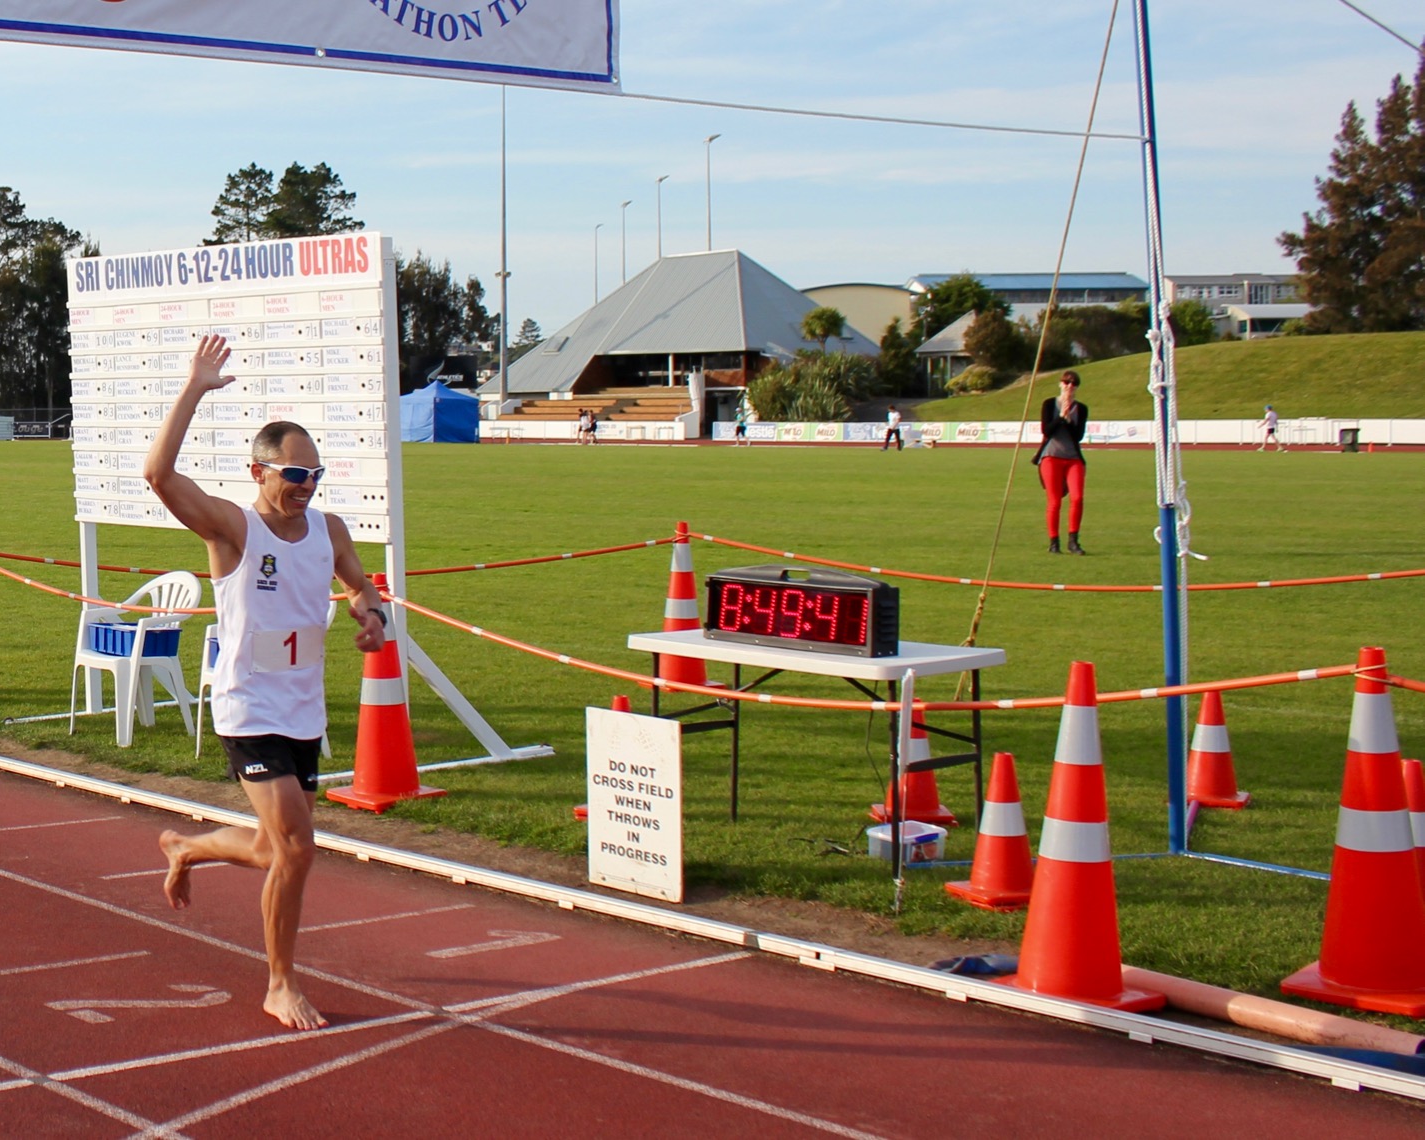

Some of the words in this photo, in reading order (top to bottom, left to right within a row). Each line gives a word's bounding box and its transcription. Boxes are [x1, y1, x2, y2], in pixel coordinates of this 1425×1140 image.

[76, 261, 100, 293] SRI
[105, 254, 173, 291] CHINMOY
[245, 242, 294, 279] HOUR
[299, 236, 369, 277] ULTRAS
[266, 297, 288, 305] 6-HOUR
[247, 327, 260, 339] 86
[365, 323, 378, 334] 64
[96, 335, 113, 346] 100
[147, 331, 158, 342] 69
[249, 355, 260, 367] 77
[306, 352, 319, 364] 55
[367, 351, 381, 362] 61
[103, 359, 113, 369] 91
[148, 359, 158, 369] 70
[102, 382, 112, 394] 86
[148, 383, 160, 393] 70
[250, 382, 260, 393] 76
[306, 380, 320, 392] 40
[368, 379, 381, 391] 57
[103, 407, 114, 417] 83
[149, 407, 160, 419] 68
[198, 408, 211, 419] 58
[250, 408, 263, 418] 72
[366, 407, 381, 419] 47
[103, 431, 114, 442] 80
[200, 432, 211, 443] 60
[817, 428, 835, 436] MILO
[958, 428, 978, 437] MILO
[368, 436, 382, 448] 34
[104, 455, 117, 468] 82
[200, 459, 213, 471] 54
[106, 482, 117, 492] 78
[108, 505, 119, 515] 78
[152, 507, 163, 518] 64
[283, 631, 297, 666] 1
[245, 764, 268, 775] NZL
[609, 758, 626, 774] DO
[630, 764, 656, 779] NOT
[593, 774, 634, 792] CROSS
[638, 782, 674, 799] FIELD
[615, 795, 652, 812] WHEN
[607, 810, 660, 831] THROWS
[627, 831, 640, 843] IN
[601, 842, 667, 866] PROGRESS
[44, 983, 233, 1025] 2
